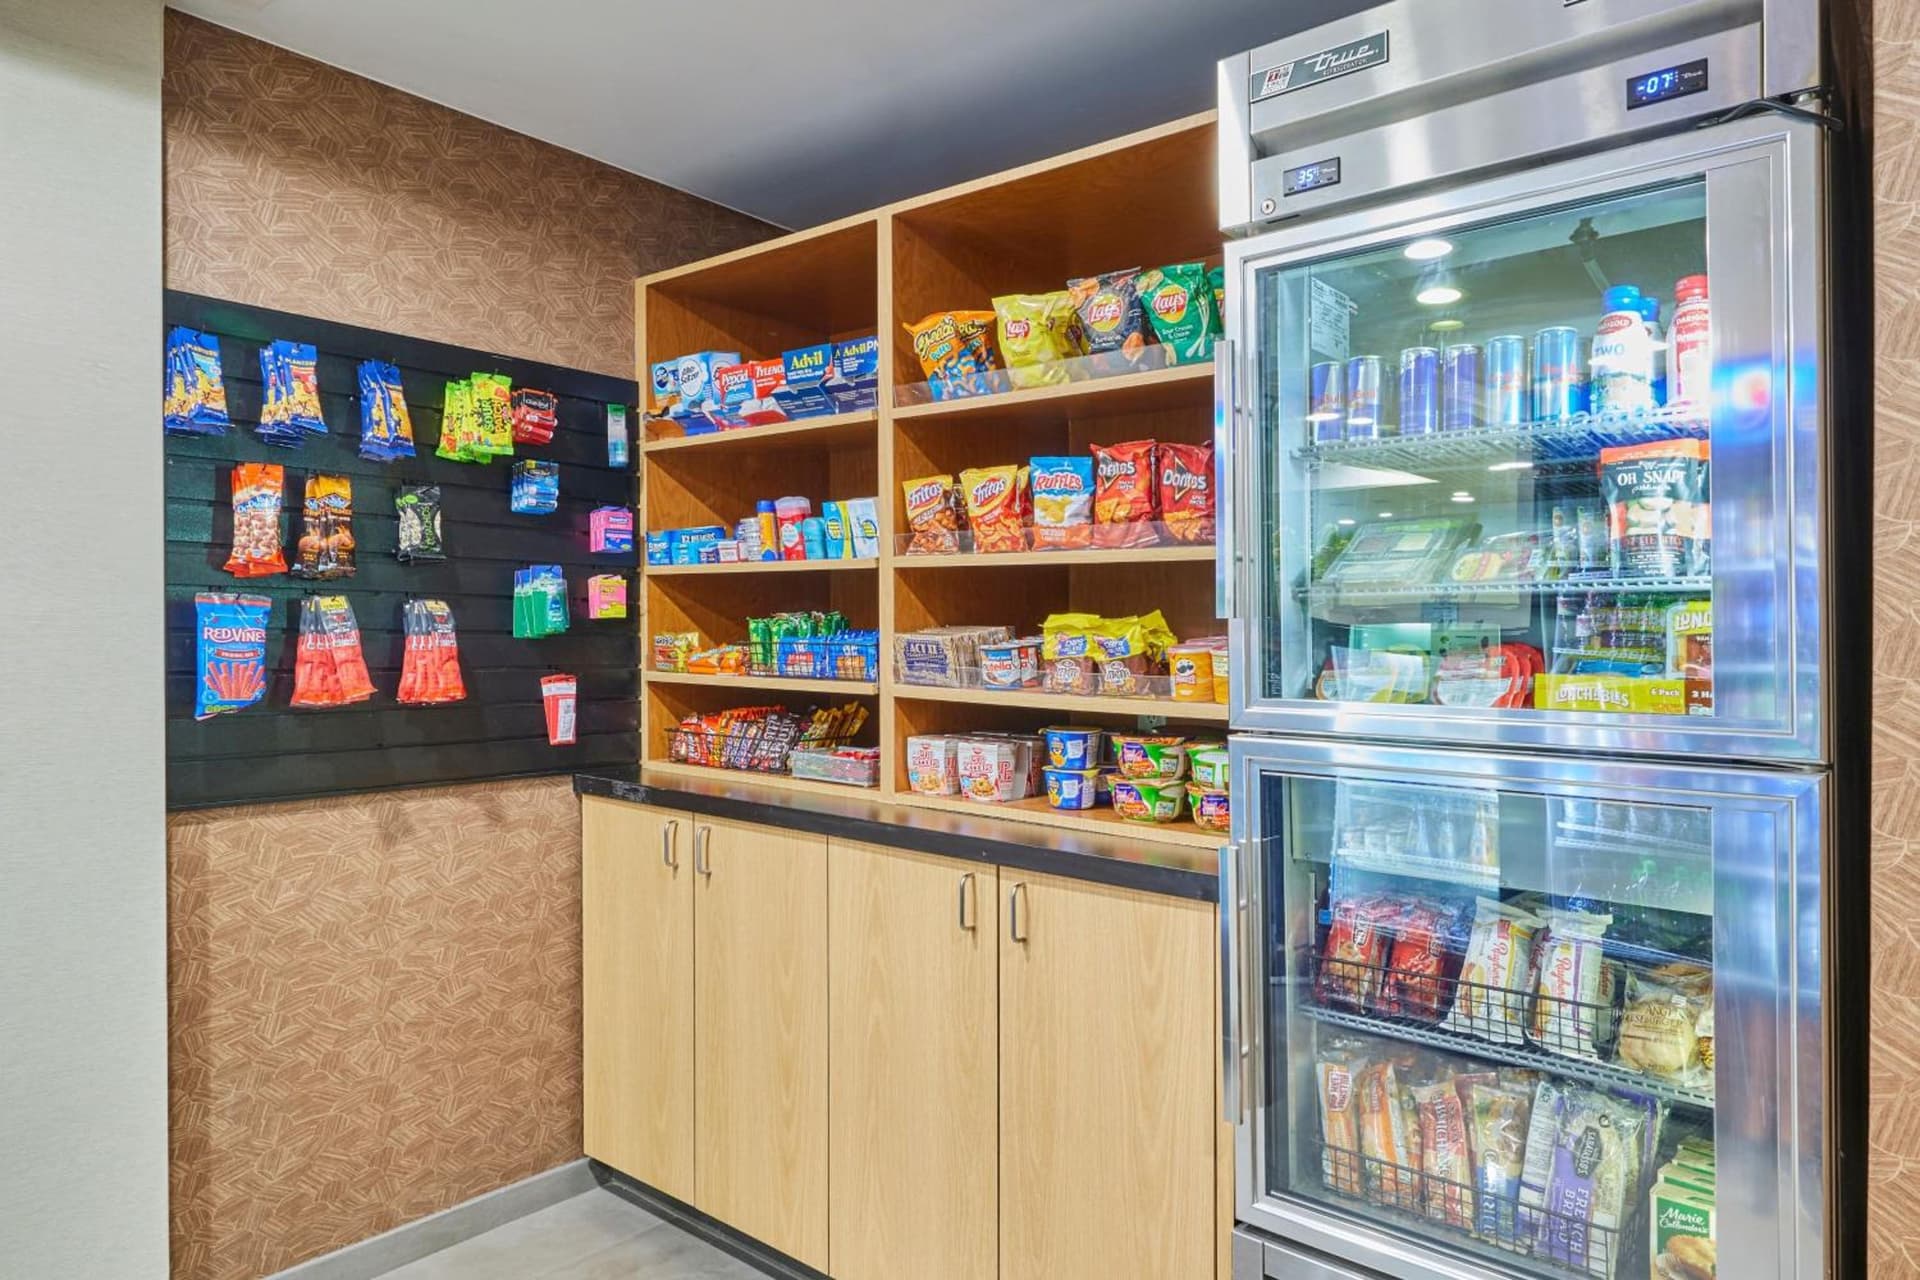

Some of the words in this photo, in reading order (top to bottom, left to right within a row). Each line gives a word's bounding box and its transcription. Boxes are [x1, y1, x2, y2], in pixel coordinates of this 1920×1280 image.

[791, 350, 824, 370] Advil
[843, 345, 866, 357] Advil
[483, 399, 494, 433] SOUR
[1033, 472, 1083, 492] RUFFLES
[1163, 469, 1207, 490] Doritos
[1617, 472, 1637, 486] OH
[1569, 1187, 1589, 1254] FRENCH
[1660, 1207, 1704, 1226] Marie
